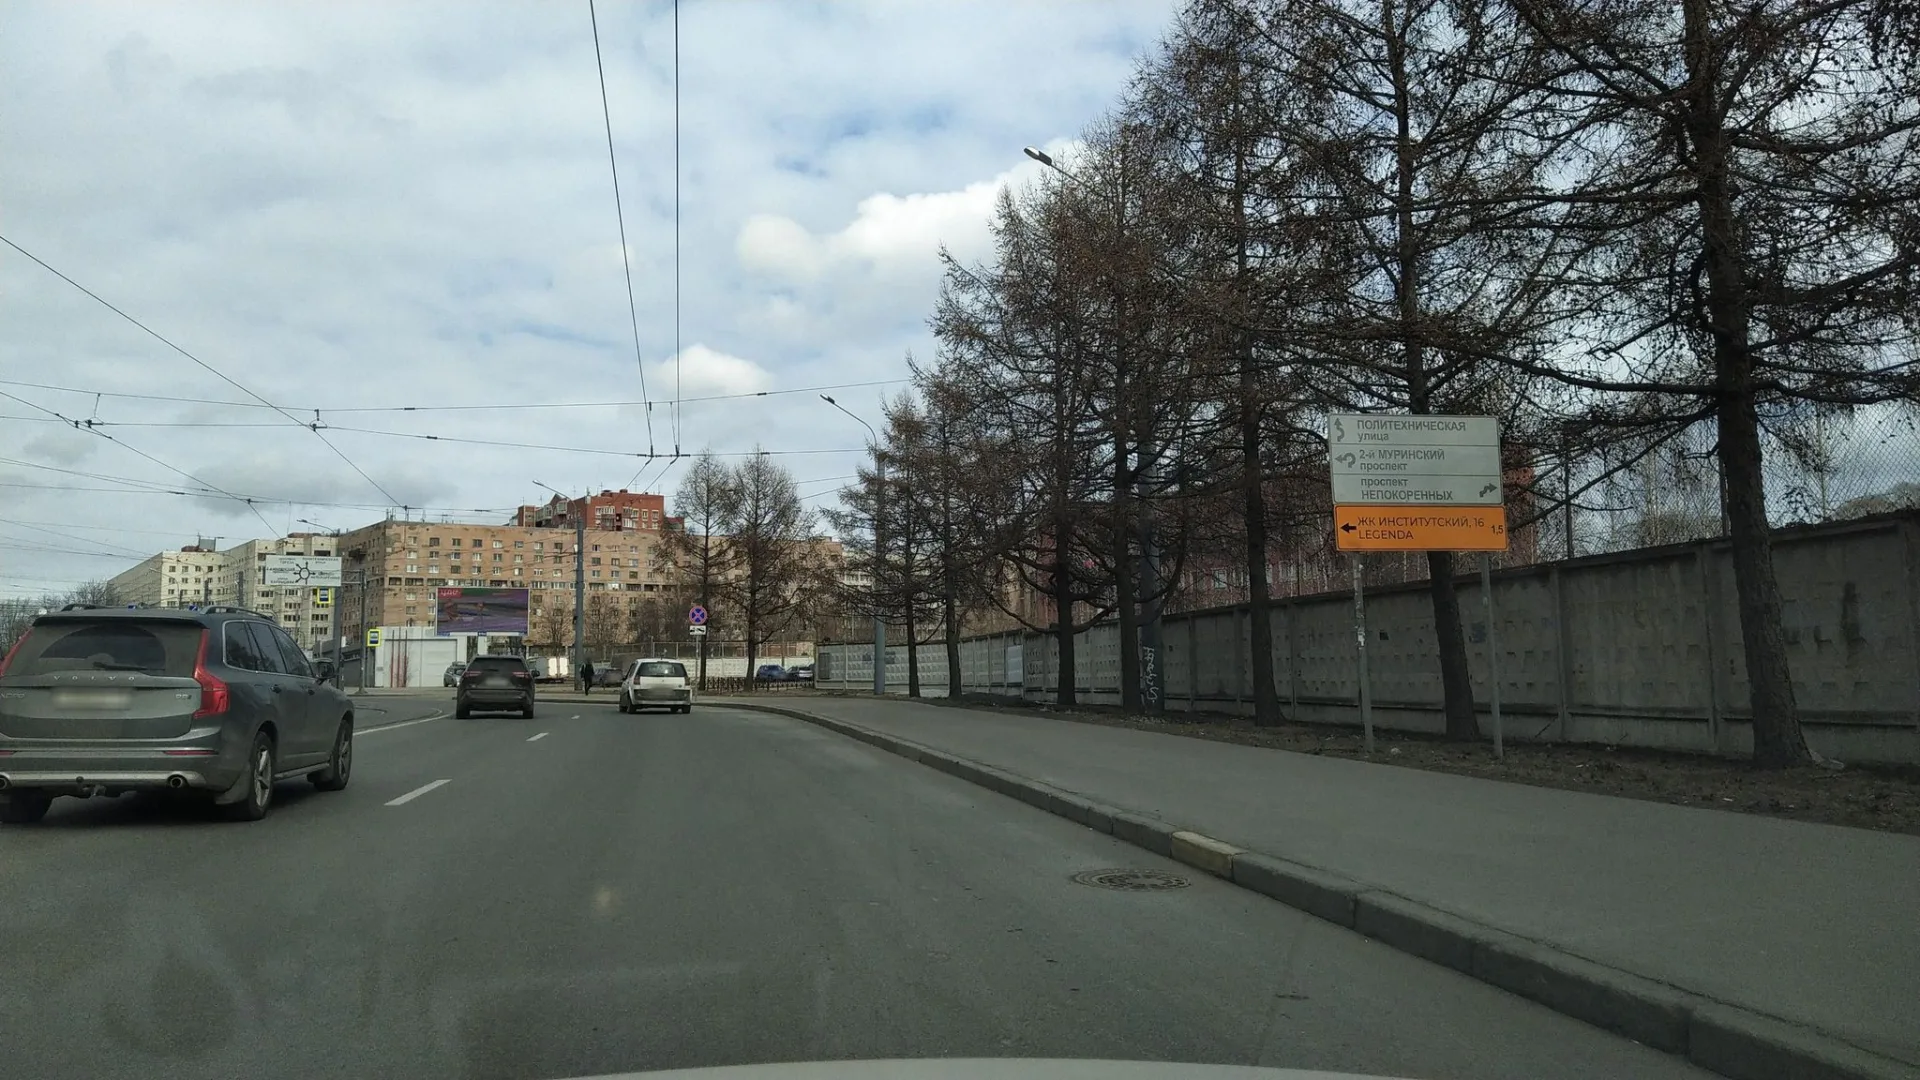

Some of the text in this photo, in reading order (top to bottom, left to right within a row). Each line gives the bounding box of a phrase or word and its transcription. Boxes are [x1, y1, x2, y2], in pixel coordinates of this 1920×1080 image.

[1357, 419, 1466, 432] ПОЛИТЕХНИЧЕСКАЯ
[1357, 432, 1390, 443] улица
[1359, 449, 1445, 461] 2-й МУРИНСКИЙ
[1360, 462, 1408, 473] проспект
[1361, 478, 1409, 489] проспект
[1361, 489, 1454, 501] НЕПОКОРЕННЫХ
[1357, 516, 1485, 529] ЖК ИНСТИТУТСКИЙ, 16
[1358, 529, 1414, 540] LEGENDA
[1491, 525, 1504, 535] 1,5
